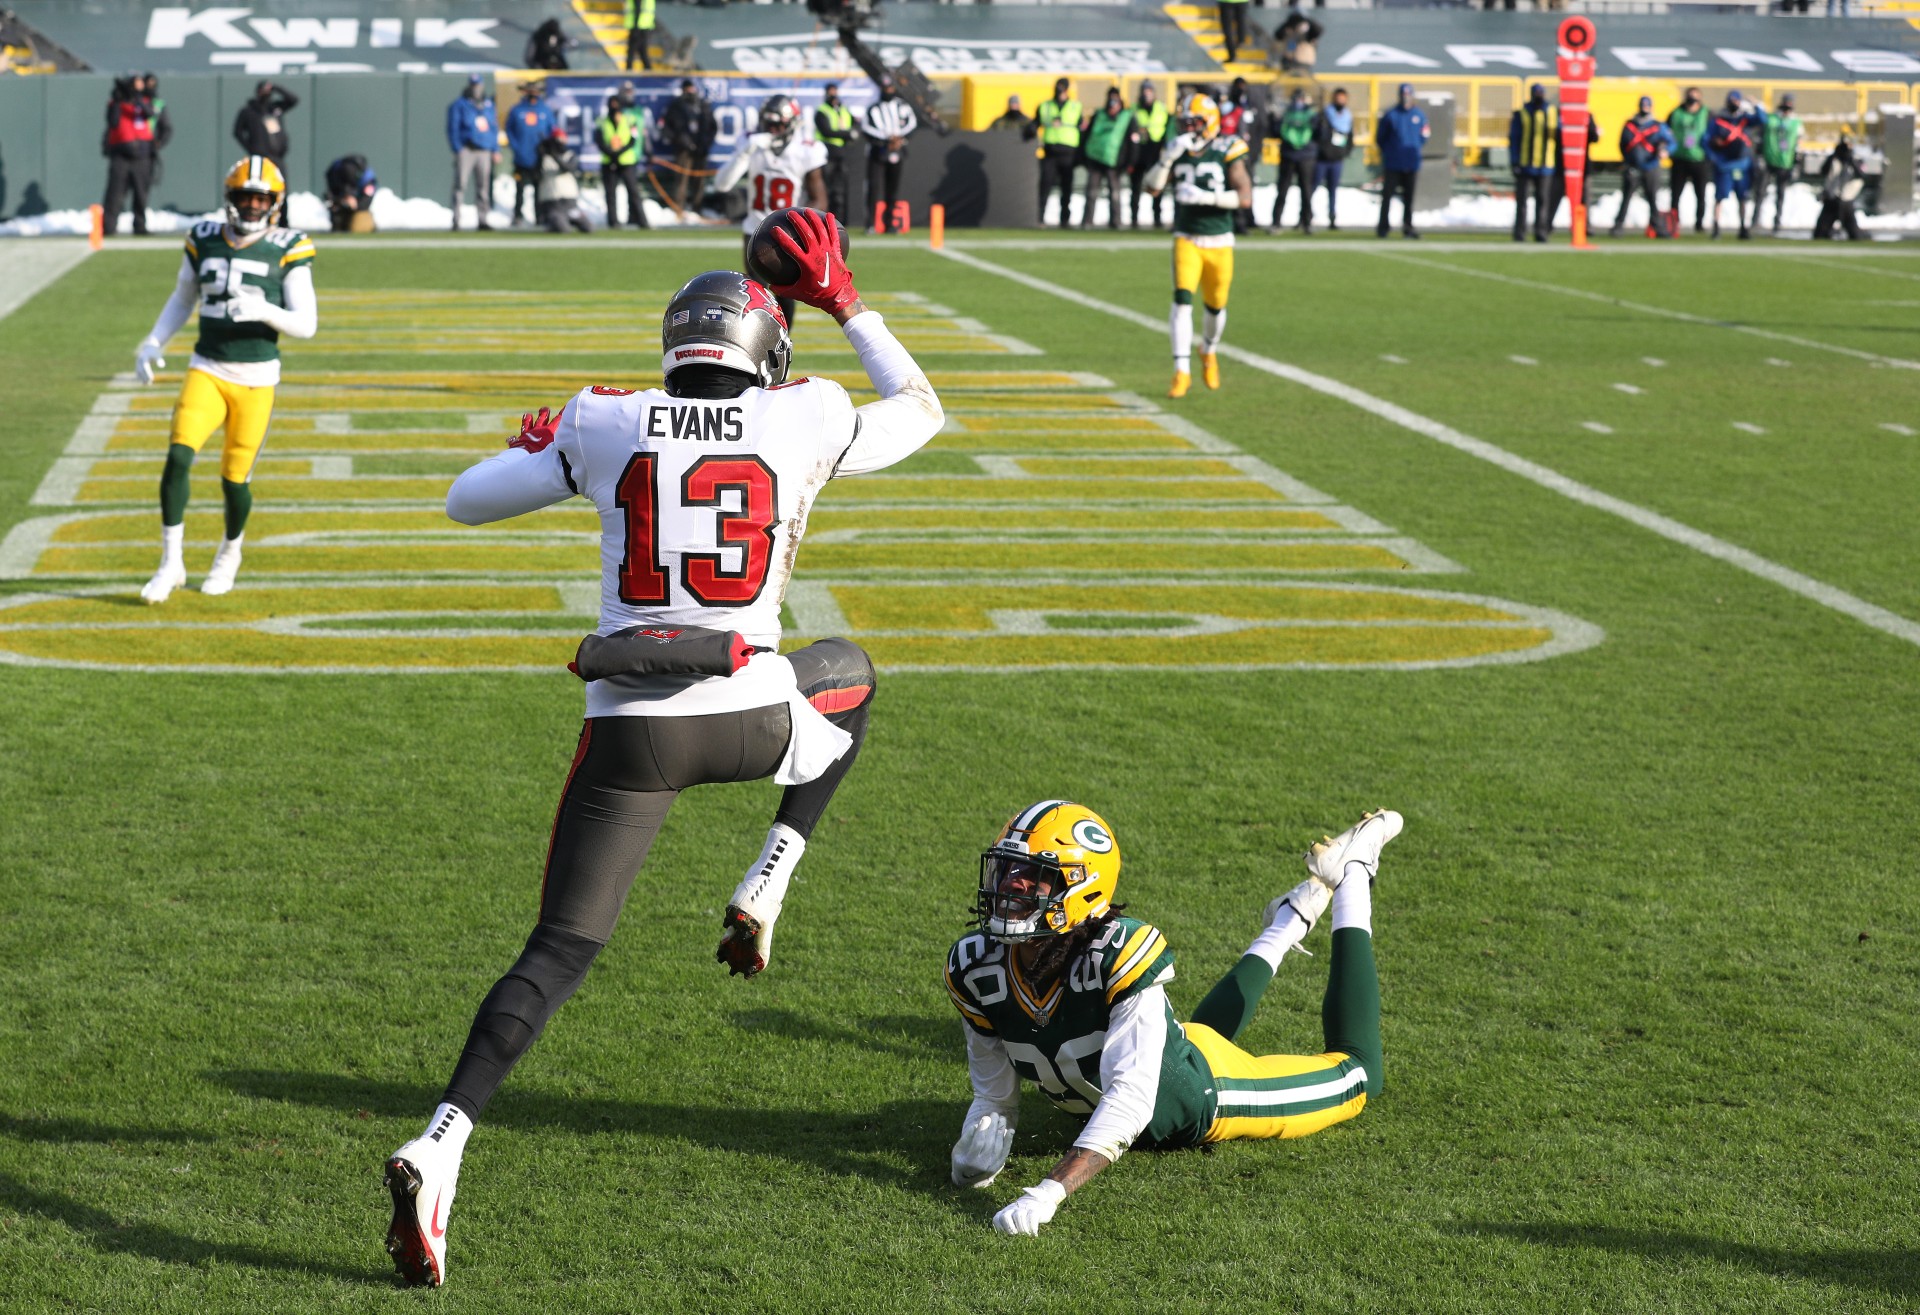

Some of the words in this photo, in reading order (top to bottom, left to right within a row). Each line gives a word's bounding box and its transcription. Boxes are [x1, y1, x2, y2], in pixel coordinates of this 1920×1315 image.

[145, 7, 500, 48] KWIK
[732, 47, 975, 68] AMERCAN
[1335, 42, 1920, 73] ARENS
[752, 173, 795, 210] 18
[199, 257, 270, 319] 25
[674, 348, 725, 361] BUCCANEERS
[647, 405, 743, 442] EVANS
[615, 452, 780, 608] 13
